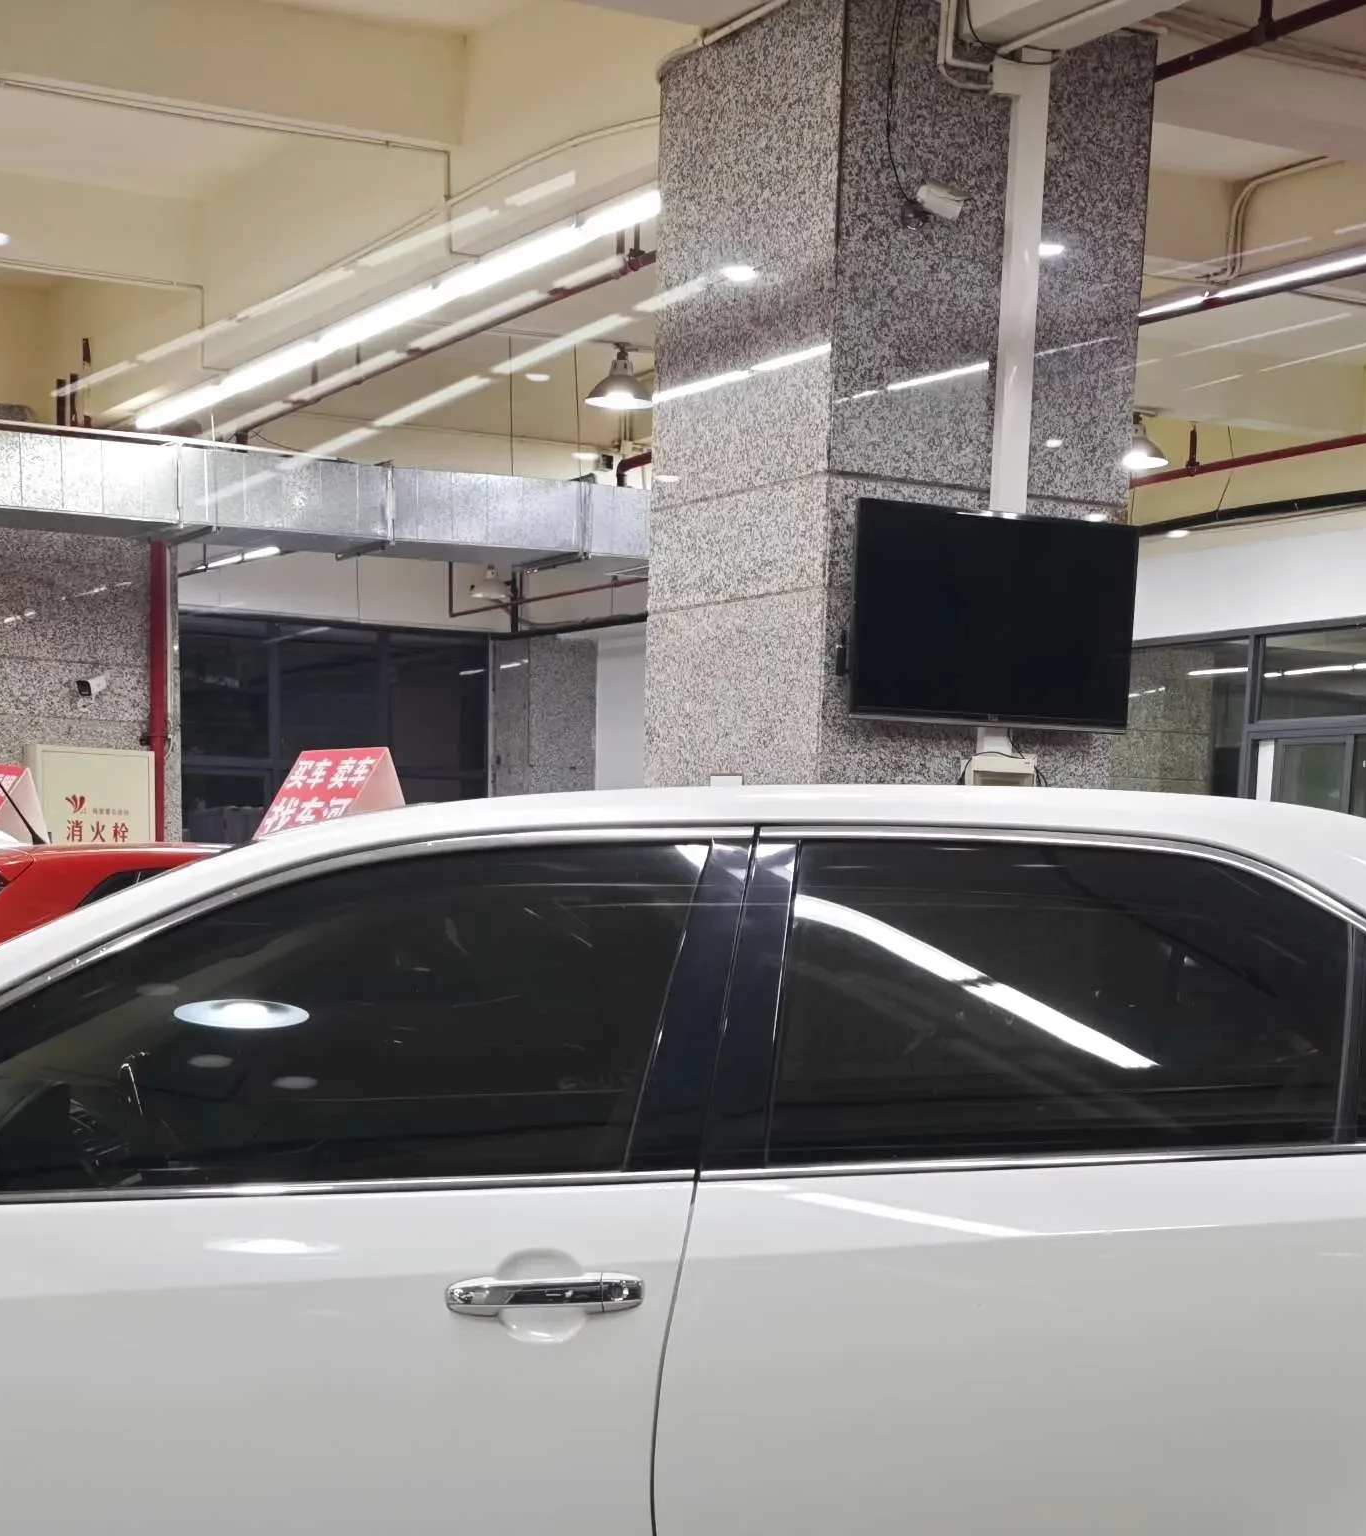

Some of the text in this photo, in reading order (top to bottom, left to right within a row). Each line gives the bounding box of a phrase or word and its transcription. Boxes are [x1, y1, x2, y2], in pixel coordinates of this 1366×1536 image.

[286, 756, 376, 790] 买车 卖车
[66, 819, 129, 842] 消火栓
